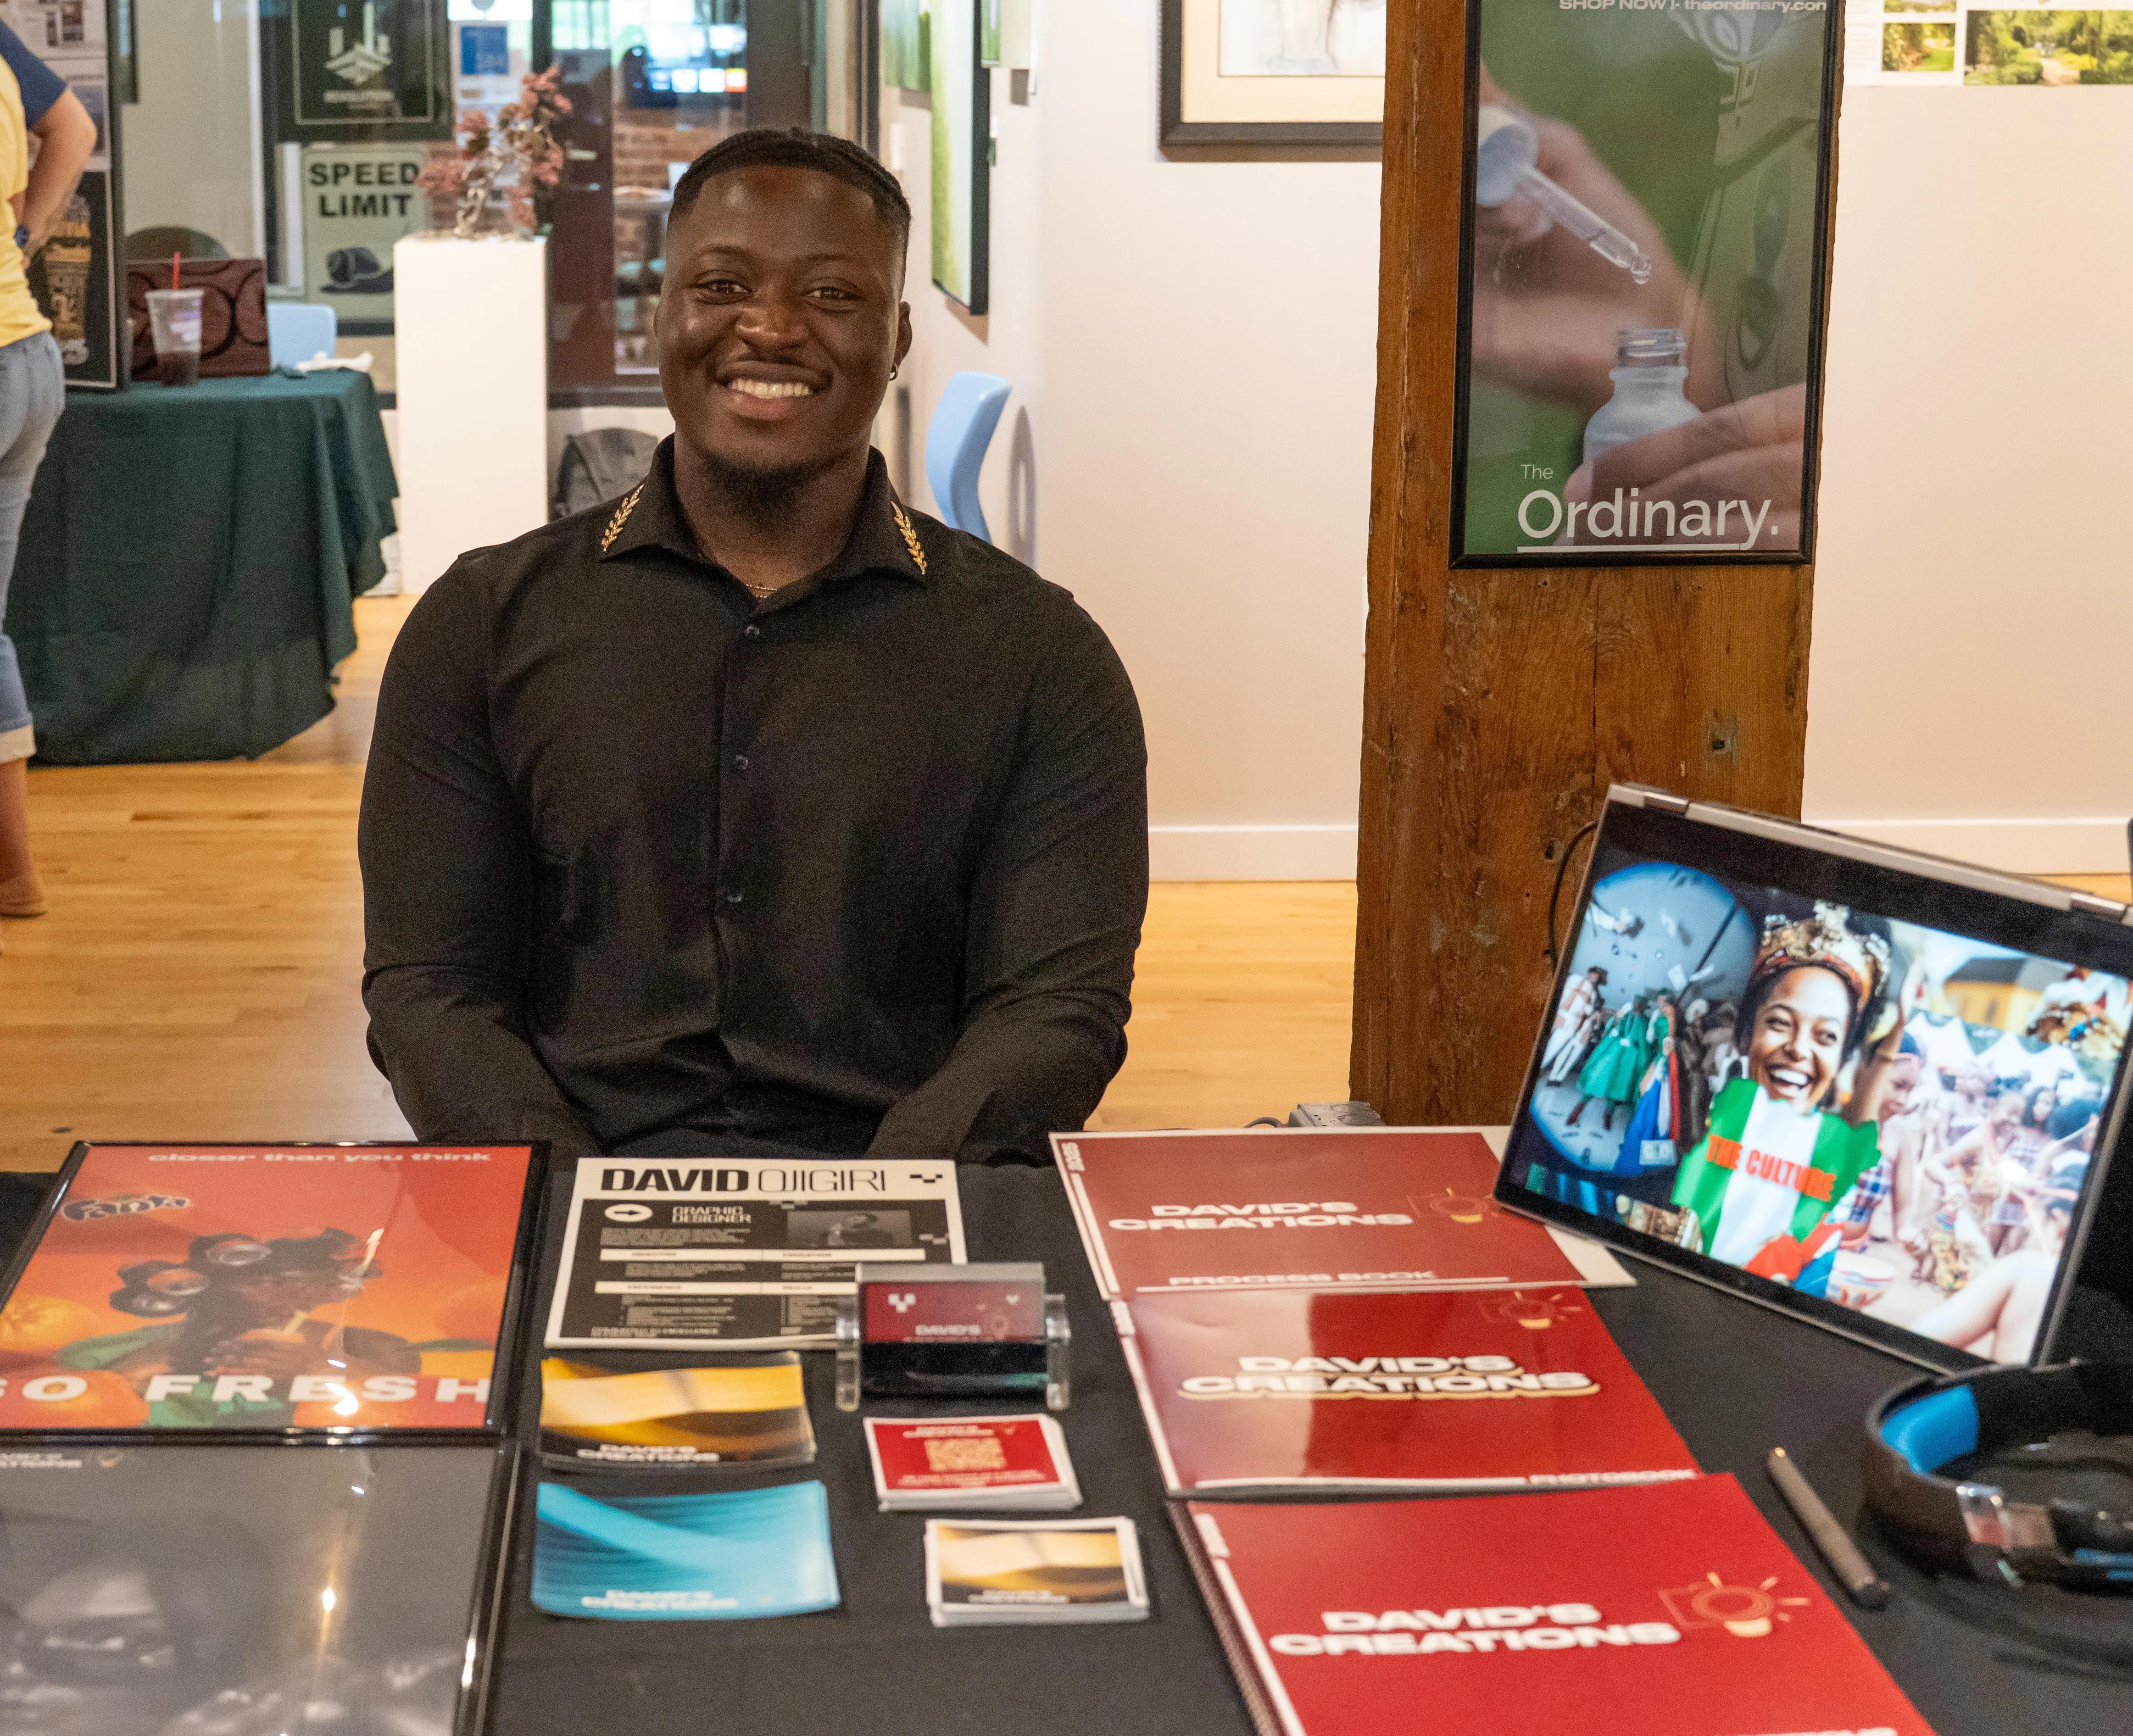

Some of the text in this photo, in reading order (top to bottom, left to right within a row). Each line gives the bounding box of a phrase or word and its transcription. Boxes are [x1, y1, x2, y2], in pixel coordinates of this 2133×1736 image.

[1560, 0, 1615, 10] SHOP
[310, 162, 419, 186] SPEED
[319, 194, 413, 217] LIMIT
[1521, 464, 1553, 479] The
[1518, 487, 1778, 550] Ordinary.
[265, 1153, 335, 1161] than
[1706, 1134, 1838, 1202] THE CULTURE
[601, 1169, 749, 1191] DAVID
[672, 1214, 752, 1224] DESIGNER
[673, 1206, 744, 1215] GRAPHIC
[1151, 1202, 1358, 1217] DAVID'S
[1108, 1214, 1413, 1230] CREATIONS
[1169, 1271, 1437, 1285] PROCESS BOOK
[1238, 1356, 1517, 1374] DAVID'S
[0, 1374, 490, 1404] O FRESH
[1181, 1372, 1594, 1396] CREATIONS
[1321, 1602, 1602, 1632] DAVID'S
[1269, 1622, 1681, 1655] CREATIONS
